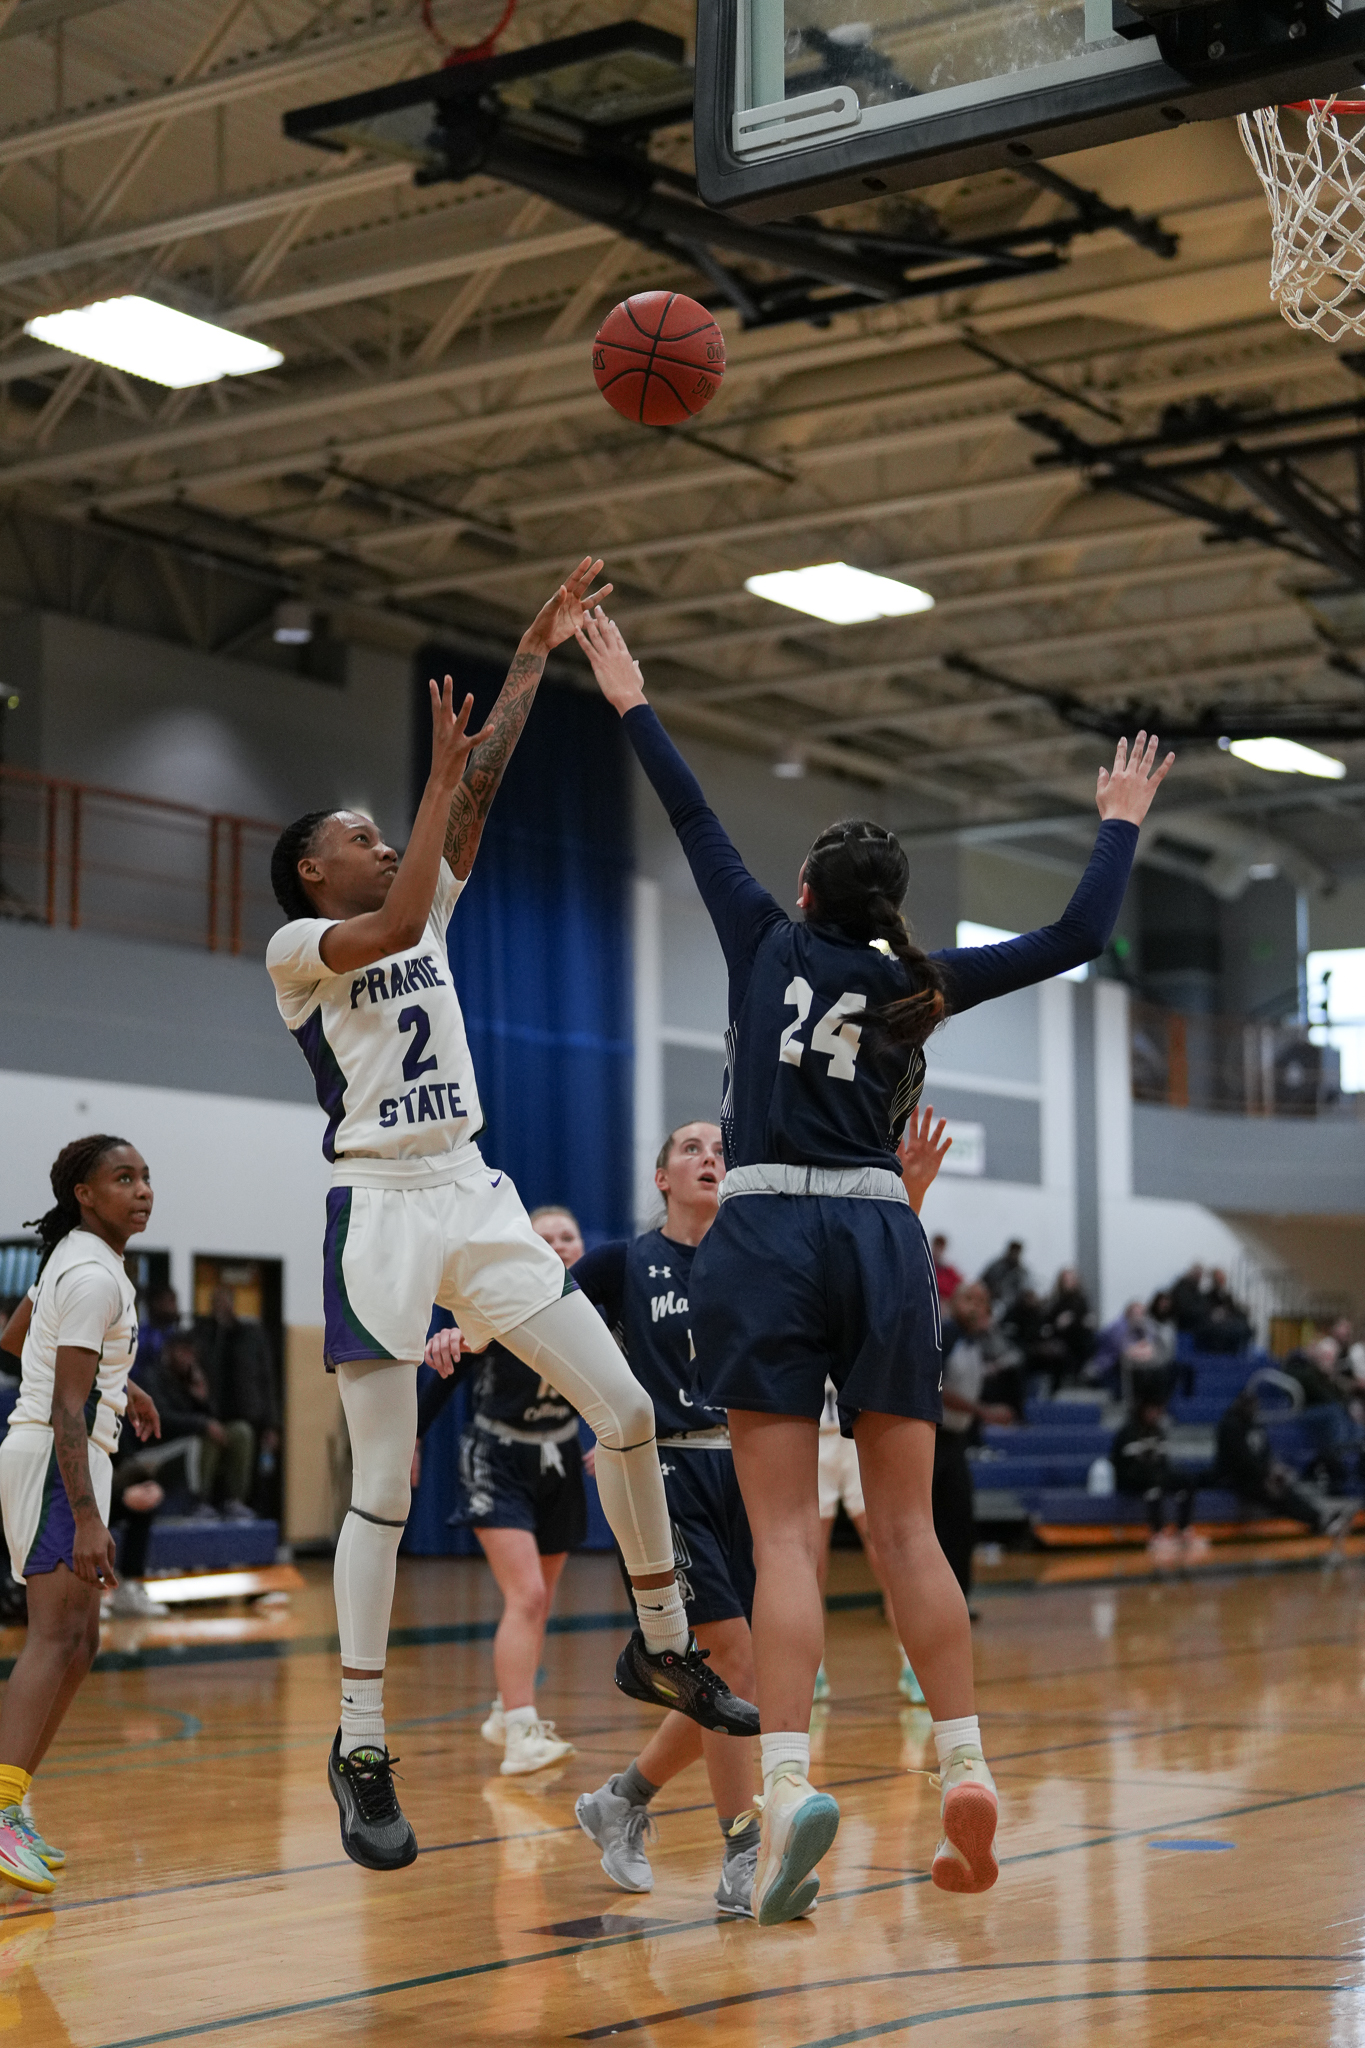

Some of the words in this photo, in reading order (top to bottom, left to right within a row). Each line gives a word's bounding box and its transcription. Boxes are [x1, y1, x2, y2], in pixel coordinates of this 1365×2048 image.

[350, 955, 447, 1010] PRAIRIE
[397, 1004, 438, 1083] 2
[778, 975, 867, 1082] 24
[378, 1082, 468, 1129] STATE
